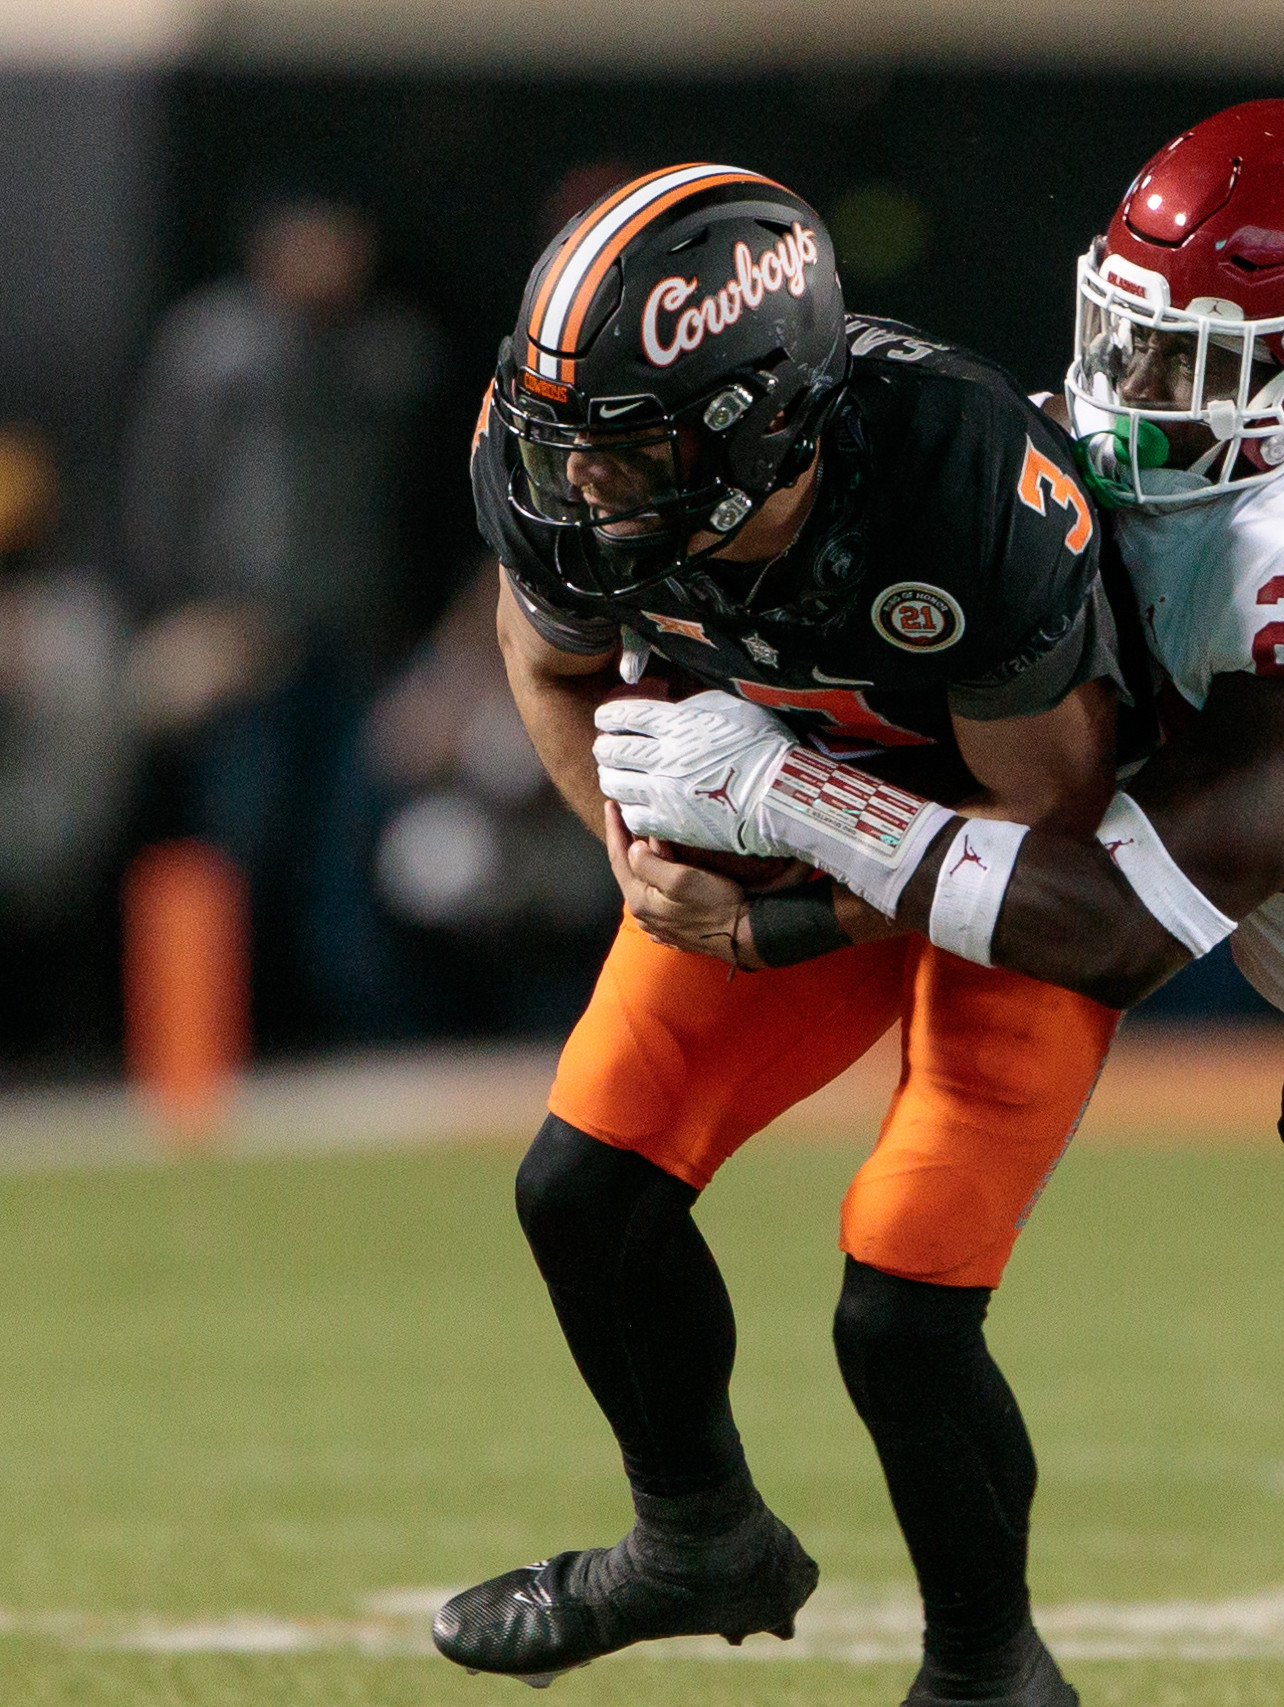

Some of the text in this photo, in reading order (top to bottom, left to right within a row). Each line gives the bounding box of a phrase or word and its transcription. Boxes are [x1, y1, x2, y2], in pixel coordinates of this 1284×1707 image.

[642, 221, 818, 368] Cowboys
[1017, 432, 1093, 555] 3
[898, 605, 937, 630] 21
